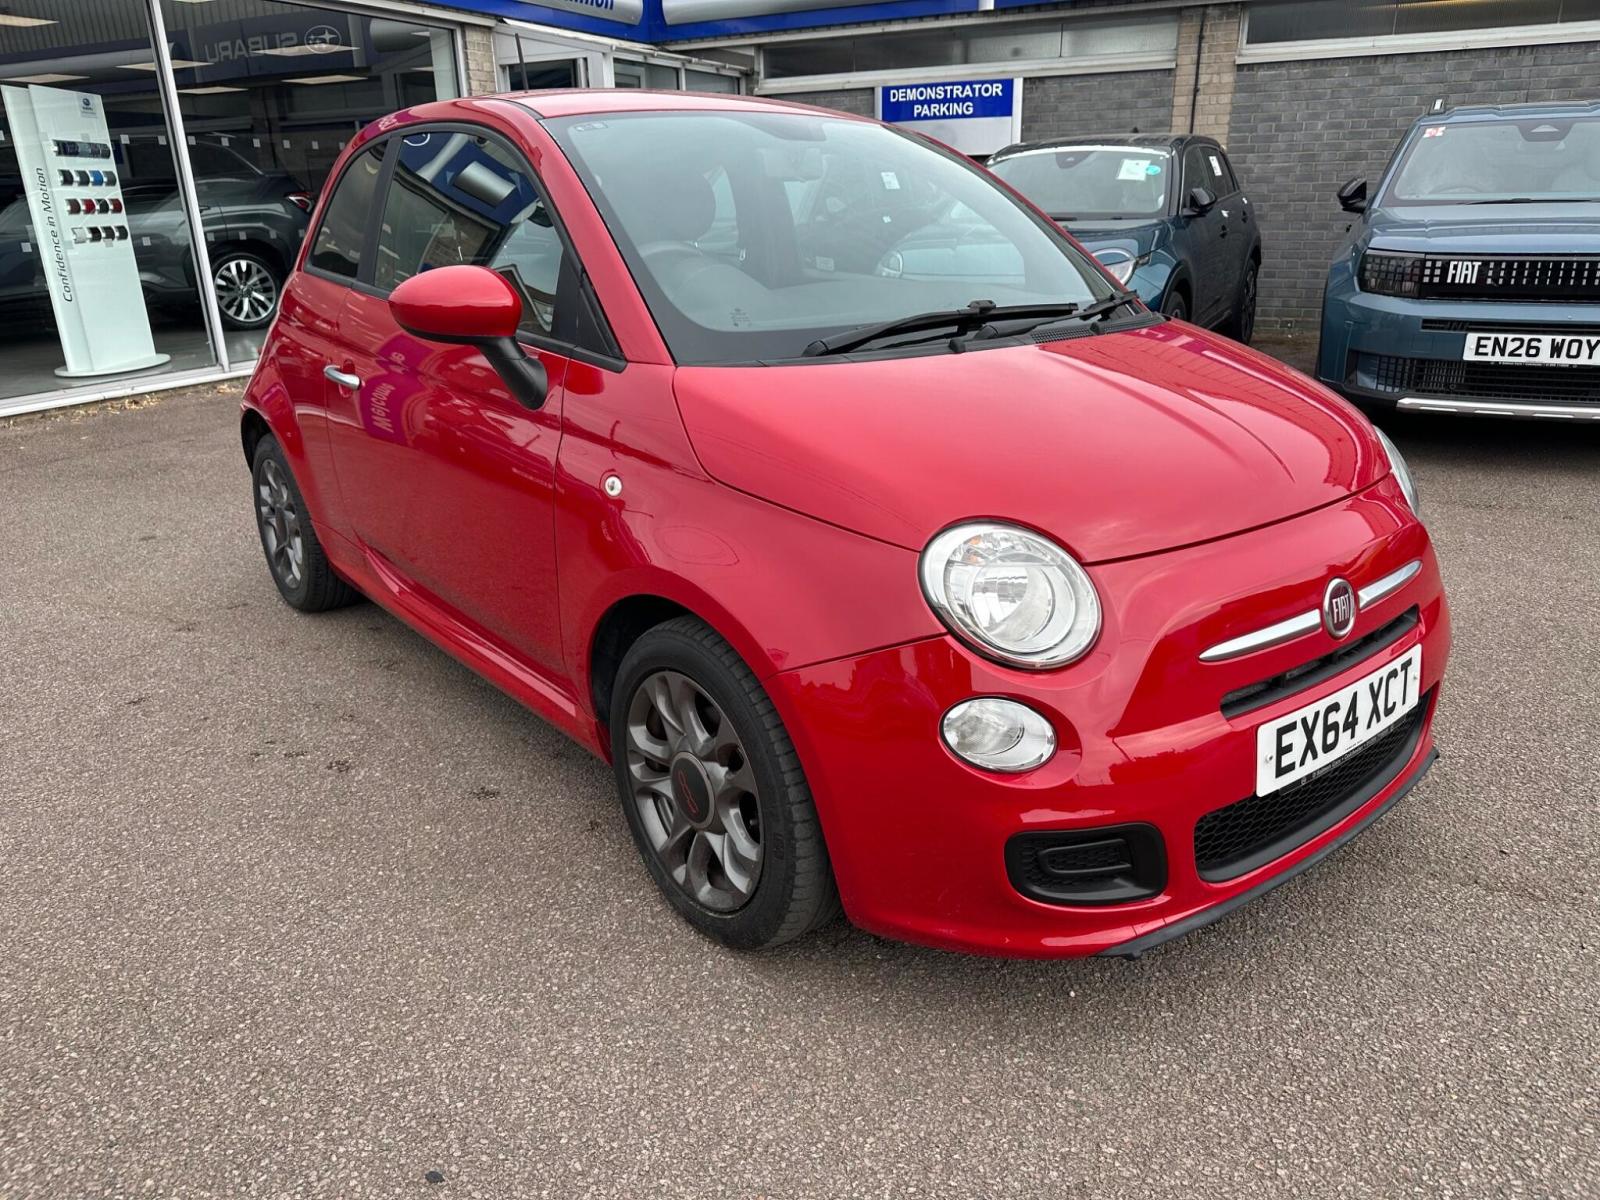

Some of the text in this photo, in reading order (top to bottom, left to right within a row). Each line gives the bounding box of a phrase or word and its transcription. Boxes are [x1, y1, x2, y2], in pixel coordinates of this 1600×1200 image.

[890, 83, 1003, 102] DEMONSTRATOR
[914, 102, 974, 118] PARKING
[35, 167, 73, 302] Confidence in Motion
[1446, 261, 1482, 284] FIAT
[1474, 336, 1542, 358] EN26
[1332, 593, 1349, 624] FIAT
[1275, 657, 1413, 779] EX64 XCT
